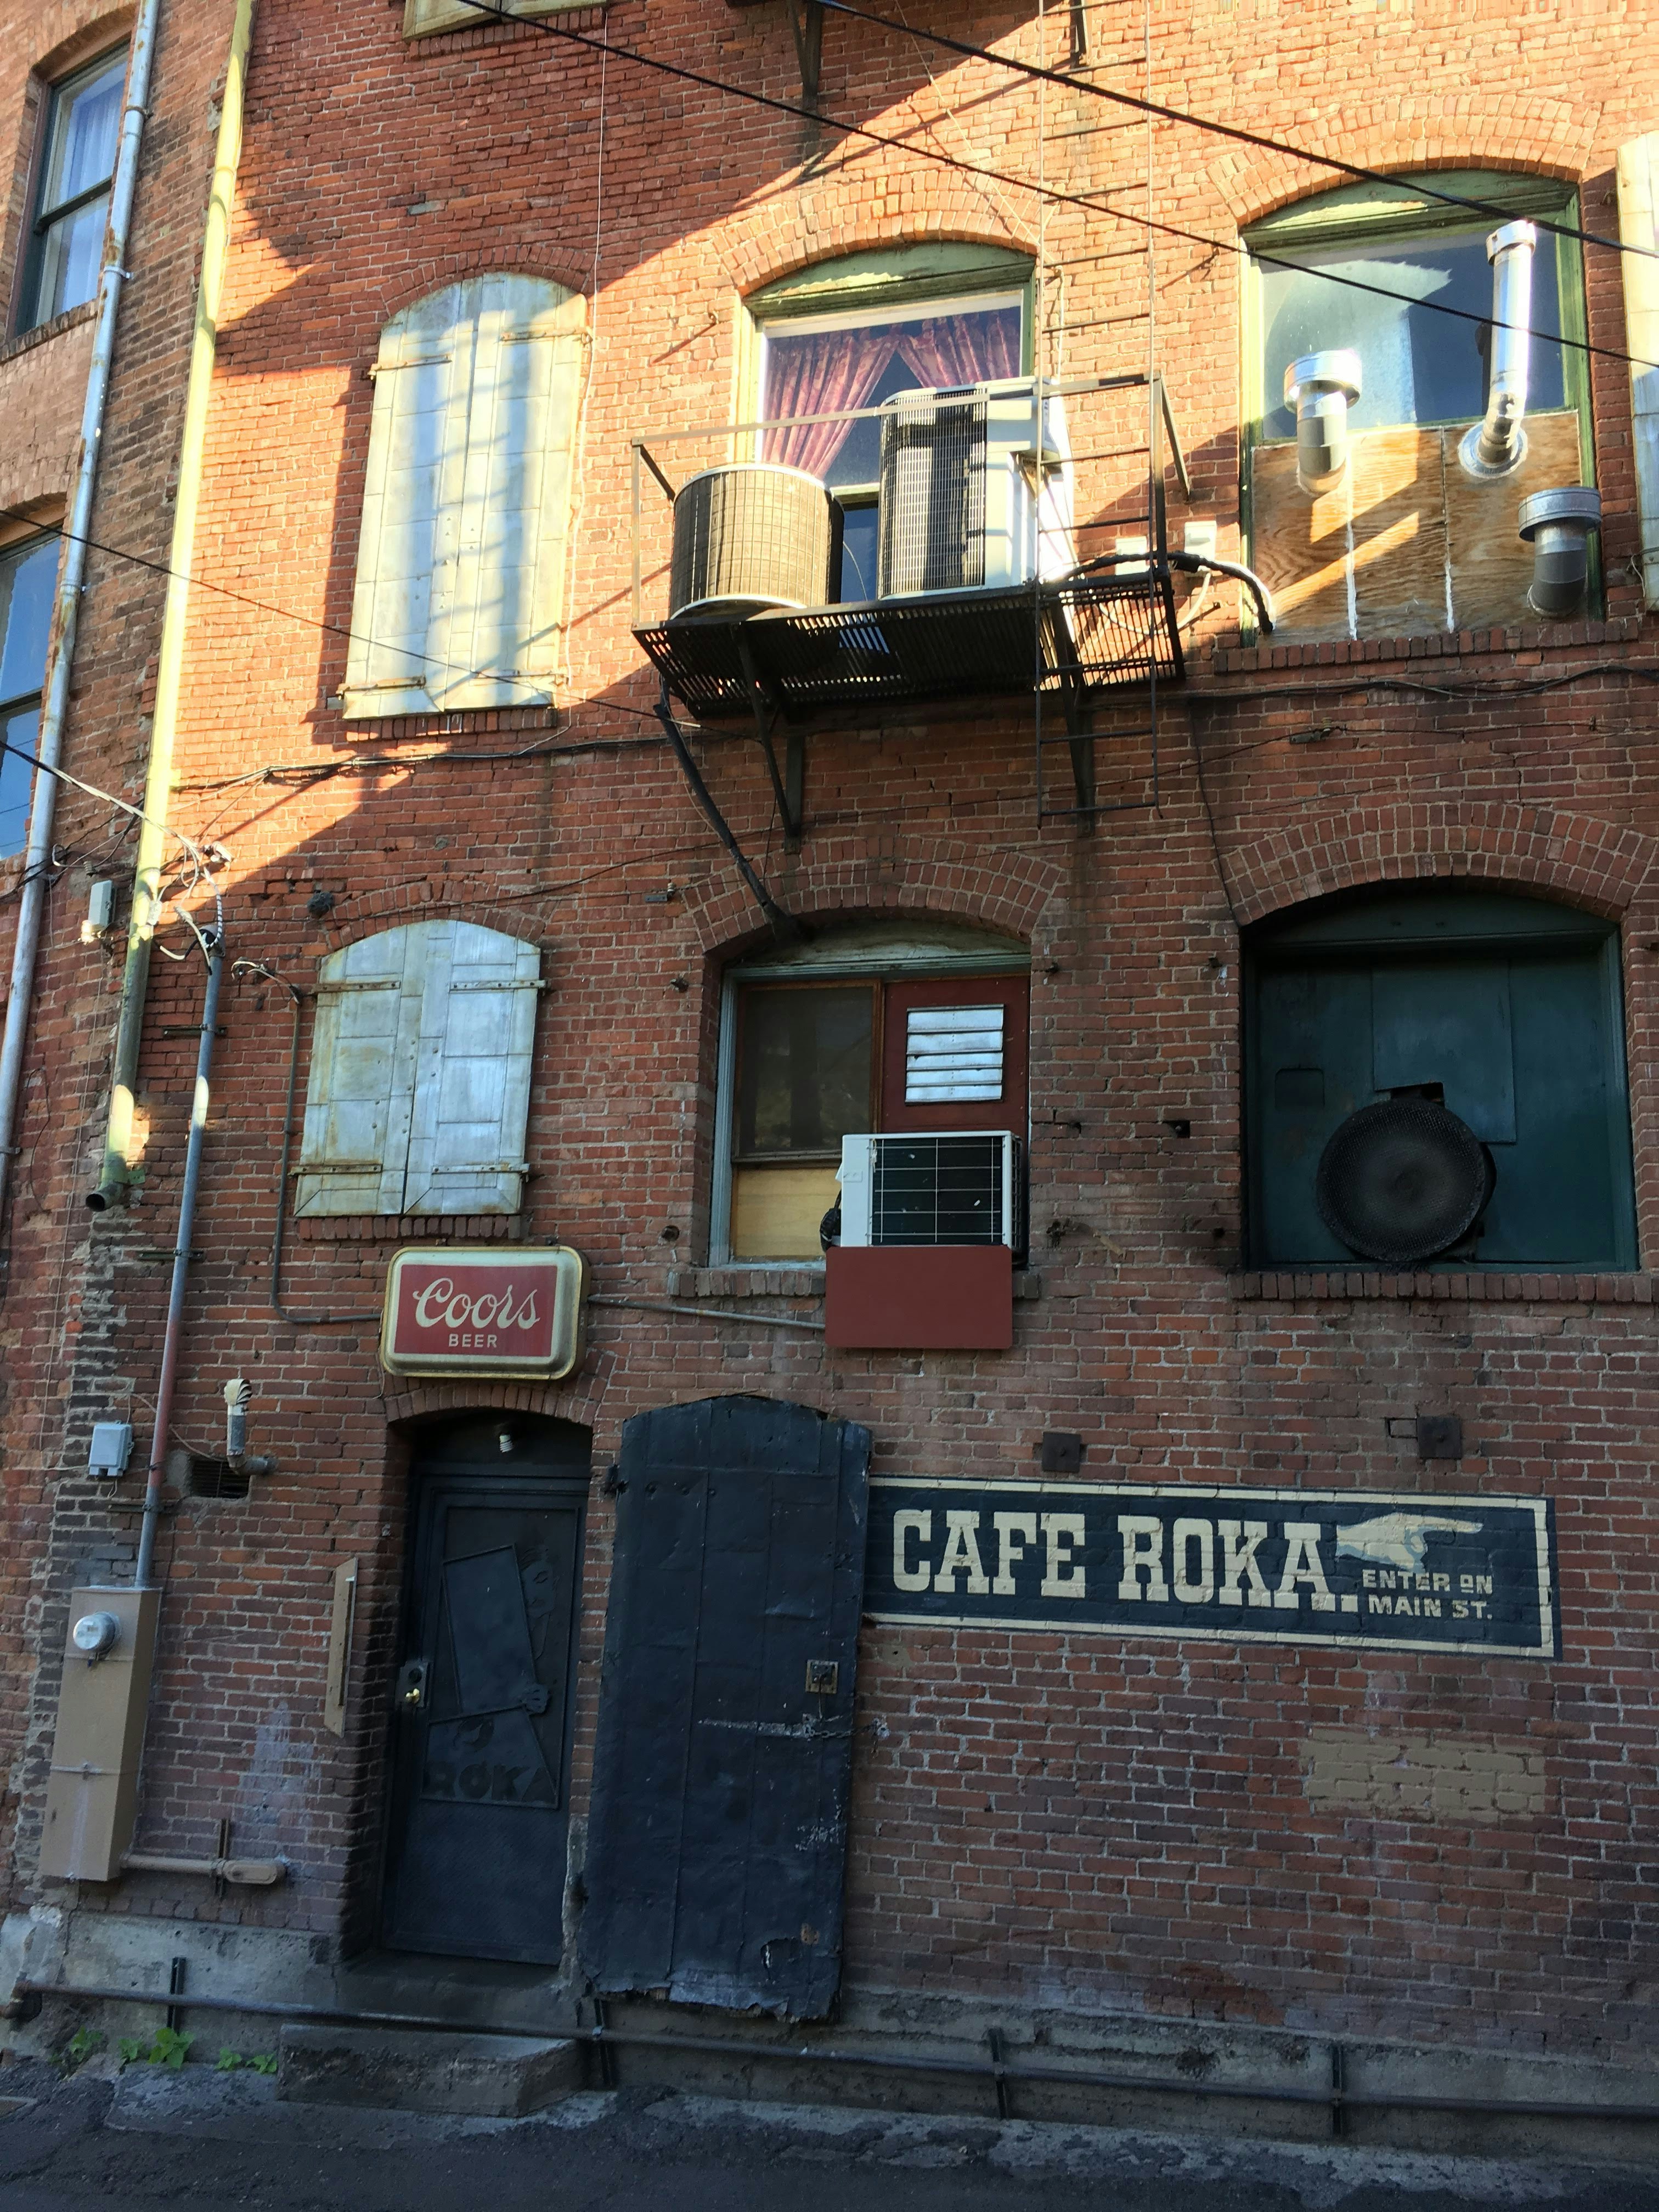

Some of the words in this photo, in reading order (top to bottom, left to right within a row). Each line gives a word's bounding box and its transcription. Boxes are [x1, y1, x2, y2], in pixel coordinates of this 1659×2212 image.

[413, 1277, 540, 1330] Coors
[449, 1334, 497, 1348] BEER
[893, 1509, 1085, 1598] CAFE
[1363, 1569, 1450, 1592] ENTER
[1369, 1594, 1442, 1617] MAIN
[1453, 1600, 1492, 1620] ST.
